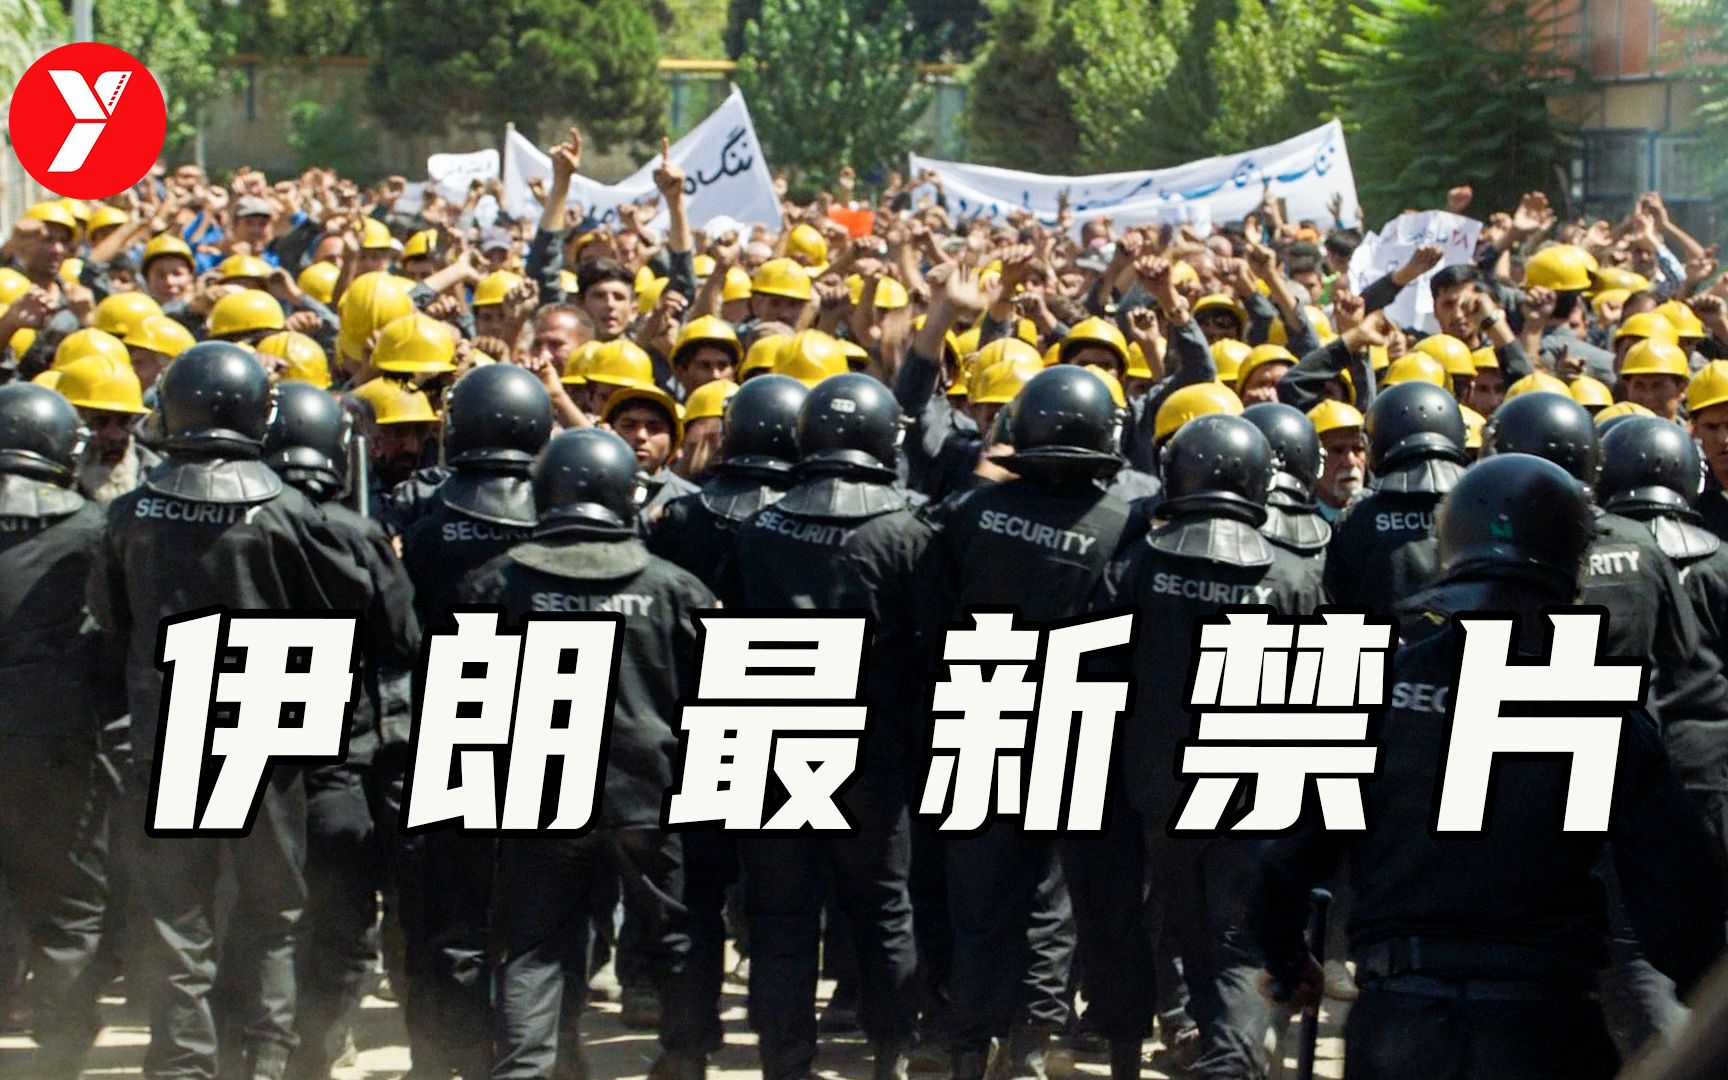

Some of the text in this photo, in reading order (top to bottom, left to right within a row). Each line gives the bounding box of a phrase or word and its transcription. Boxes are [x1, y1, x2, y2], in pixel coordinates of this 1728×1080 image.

[135, 498, 262, 525] SECURITY
[755, 510, 857, 547] SECURITY
[978, 509, 1096, 555] SECURITY
[531, 592, 655, 617] SECURITY
[1152, 572, 1273, 605] SECURITY
